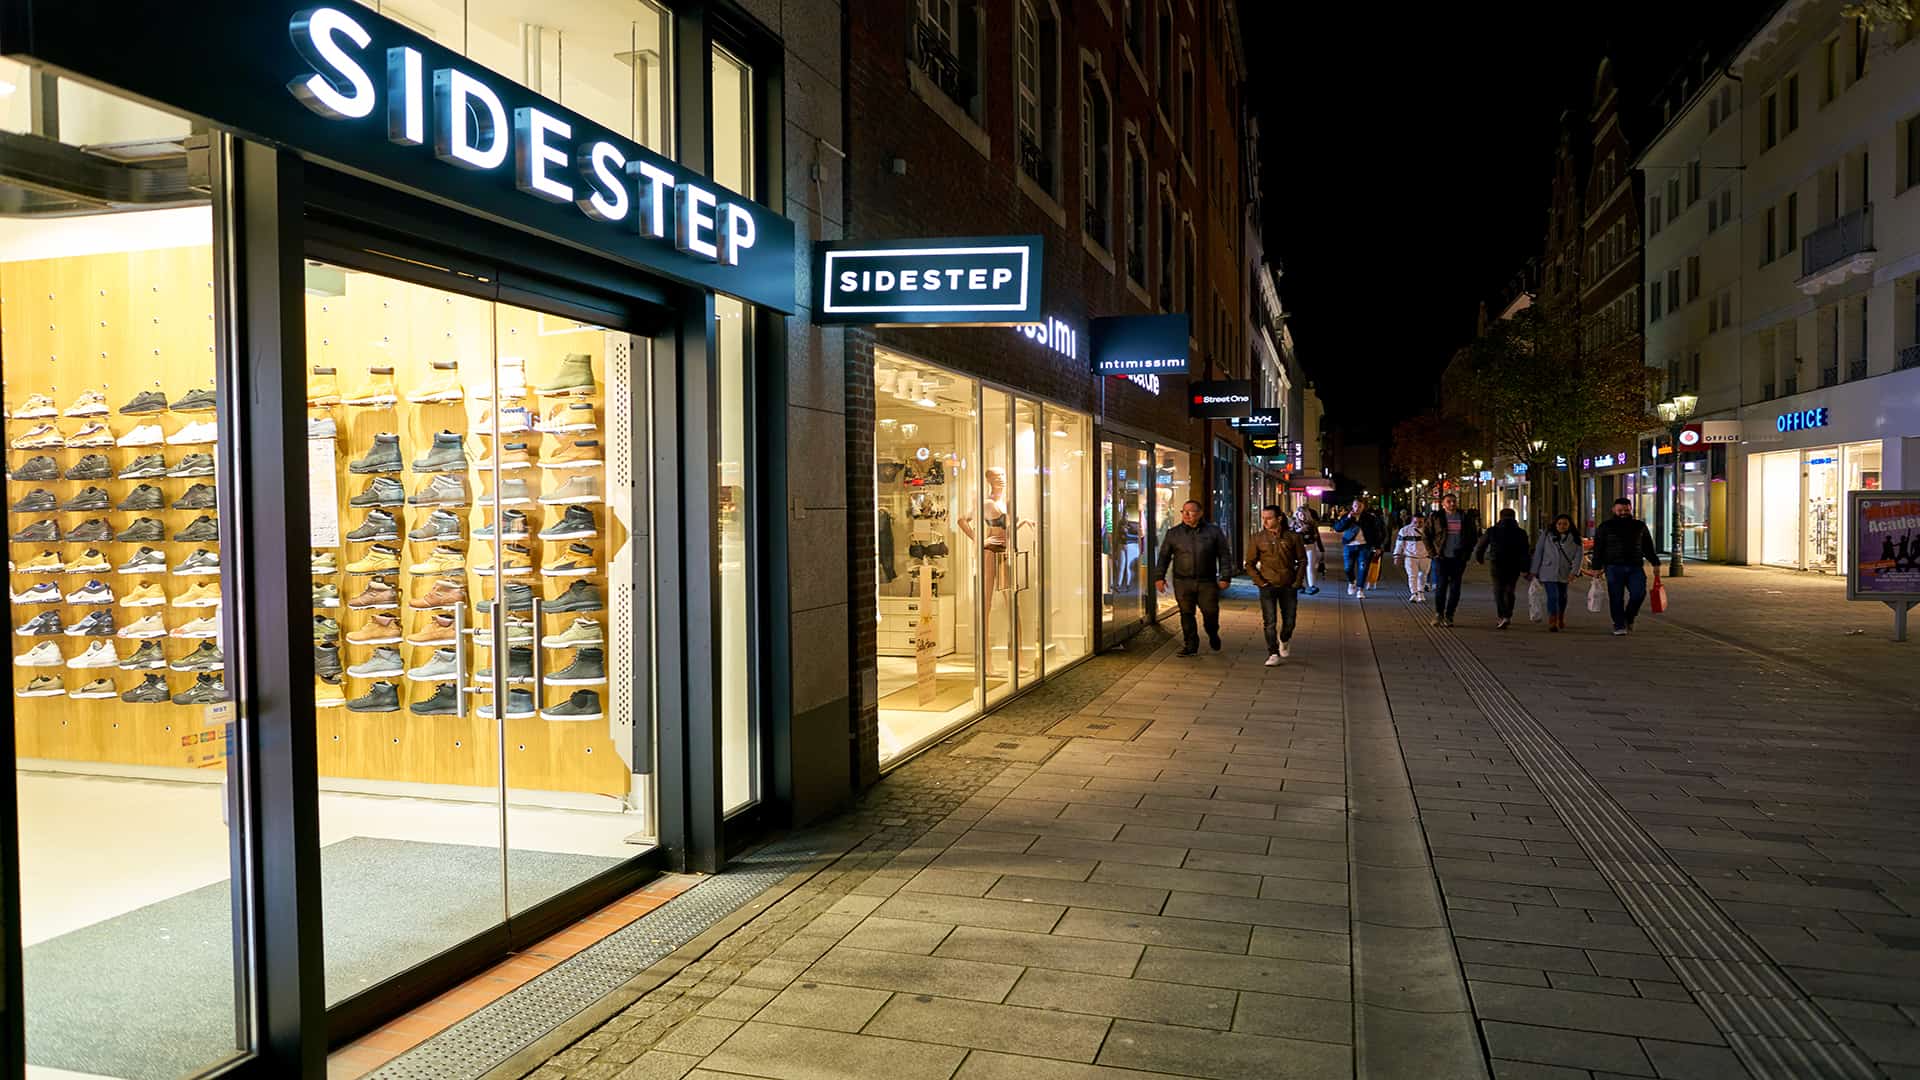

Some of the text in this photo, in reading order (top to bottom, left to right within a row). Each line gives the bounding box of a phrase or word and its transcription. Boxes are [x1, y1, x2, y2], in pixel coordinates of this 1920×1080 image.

[289, 8, 756, 267] SIDESTEP
[839, 267, 1013, 293] SIDESTEP
[1099, 358, 1186, 370] intimissimi
[1203, 395, 1249, 403] Street One
[1776, 407, 1825, 432] OFFICE
[1705, 434, 1740, 443] OFFICE
